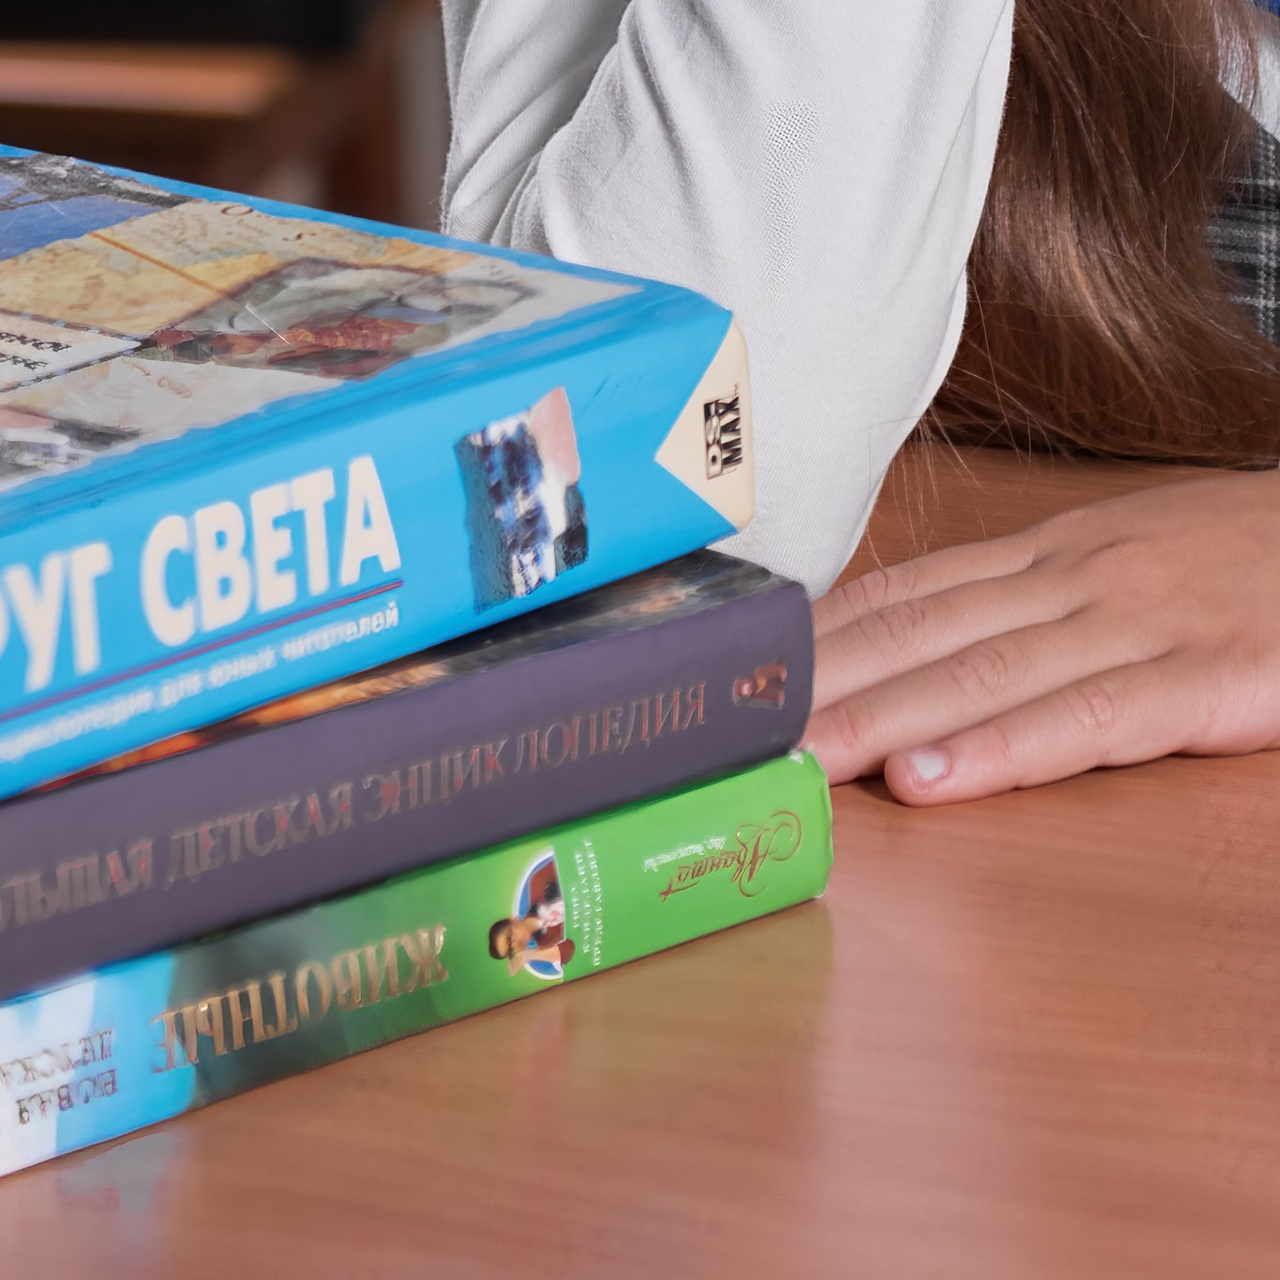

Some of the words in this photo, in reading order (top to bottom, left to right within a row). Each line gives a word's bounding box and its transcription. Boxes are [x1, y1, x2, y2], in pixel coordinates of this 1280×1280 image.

[716, 396, 743, 469] MAX
[0, 541, 113, 692] УГ
[142, 455, 401, 647] СВЕТА
[163, 785, 353, 890] ДЕТСКАЯ
[362, 682, 706, 824] ЭНЦИКЛОПЕДИЯ
[149, 924, 448, 1073] ЖИВОТНЫЕ
